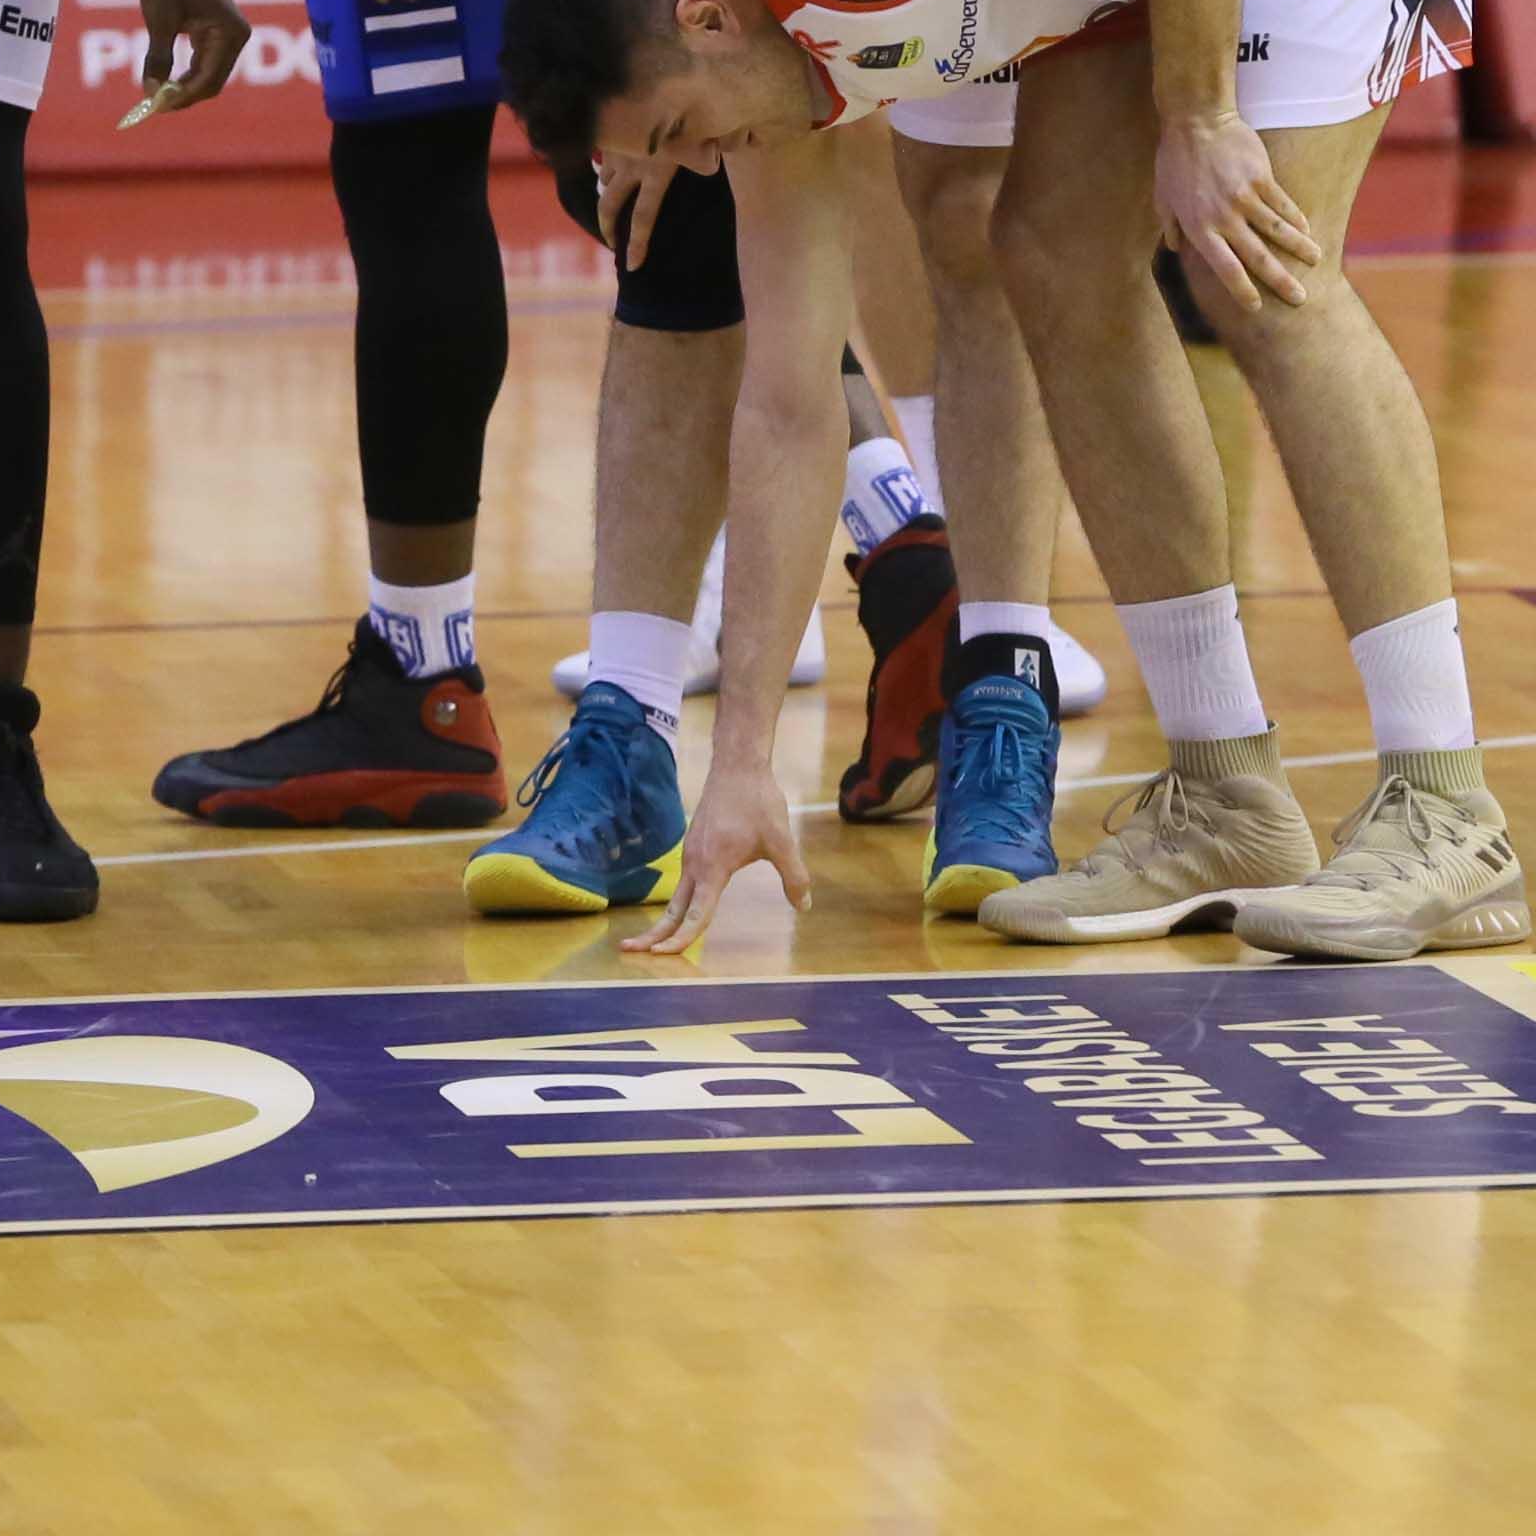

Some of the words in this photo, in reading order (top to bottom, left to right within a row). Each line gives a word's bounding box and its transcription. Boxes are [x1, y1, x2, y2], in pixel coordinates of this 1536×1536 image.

[383, 1018, 974, 1160] LBA
[887, 993, 1327, 1166] LEGABASKET
[1218, 1014, 1407, 1034] A
